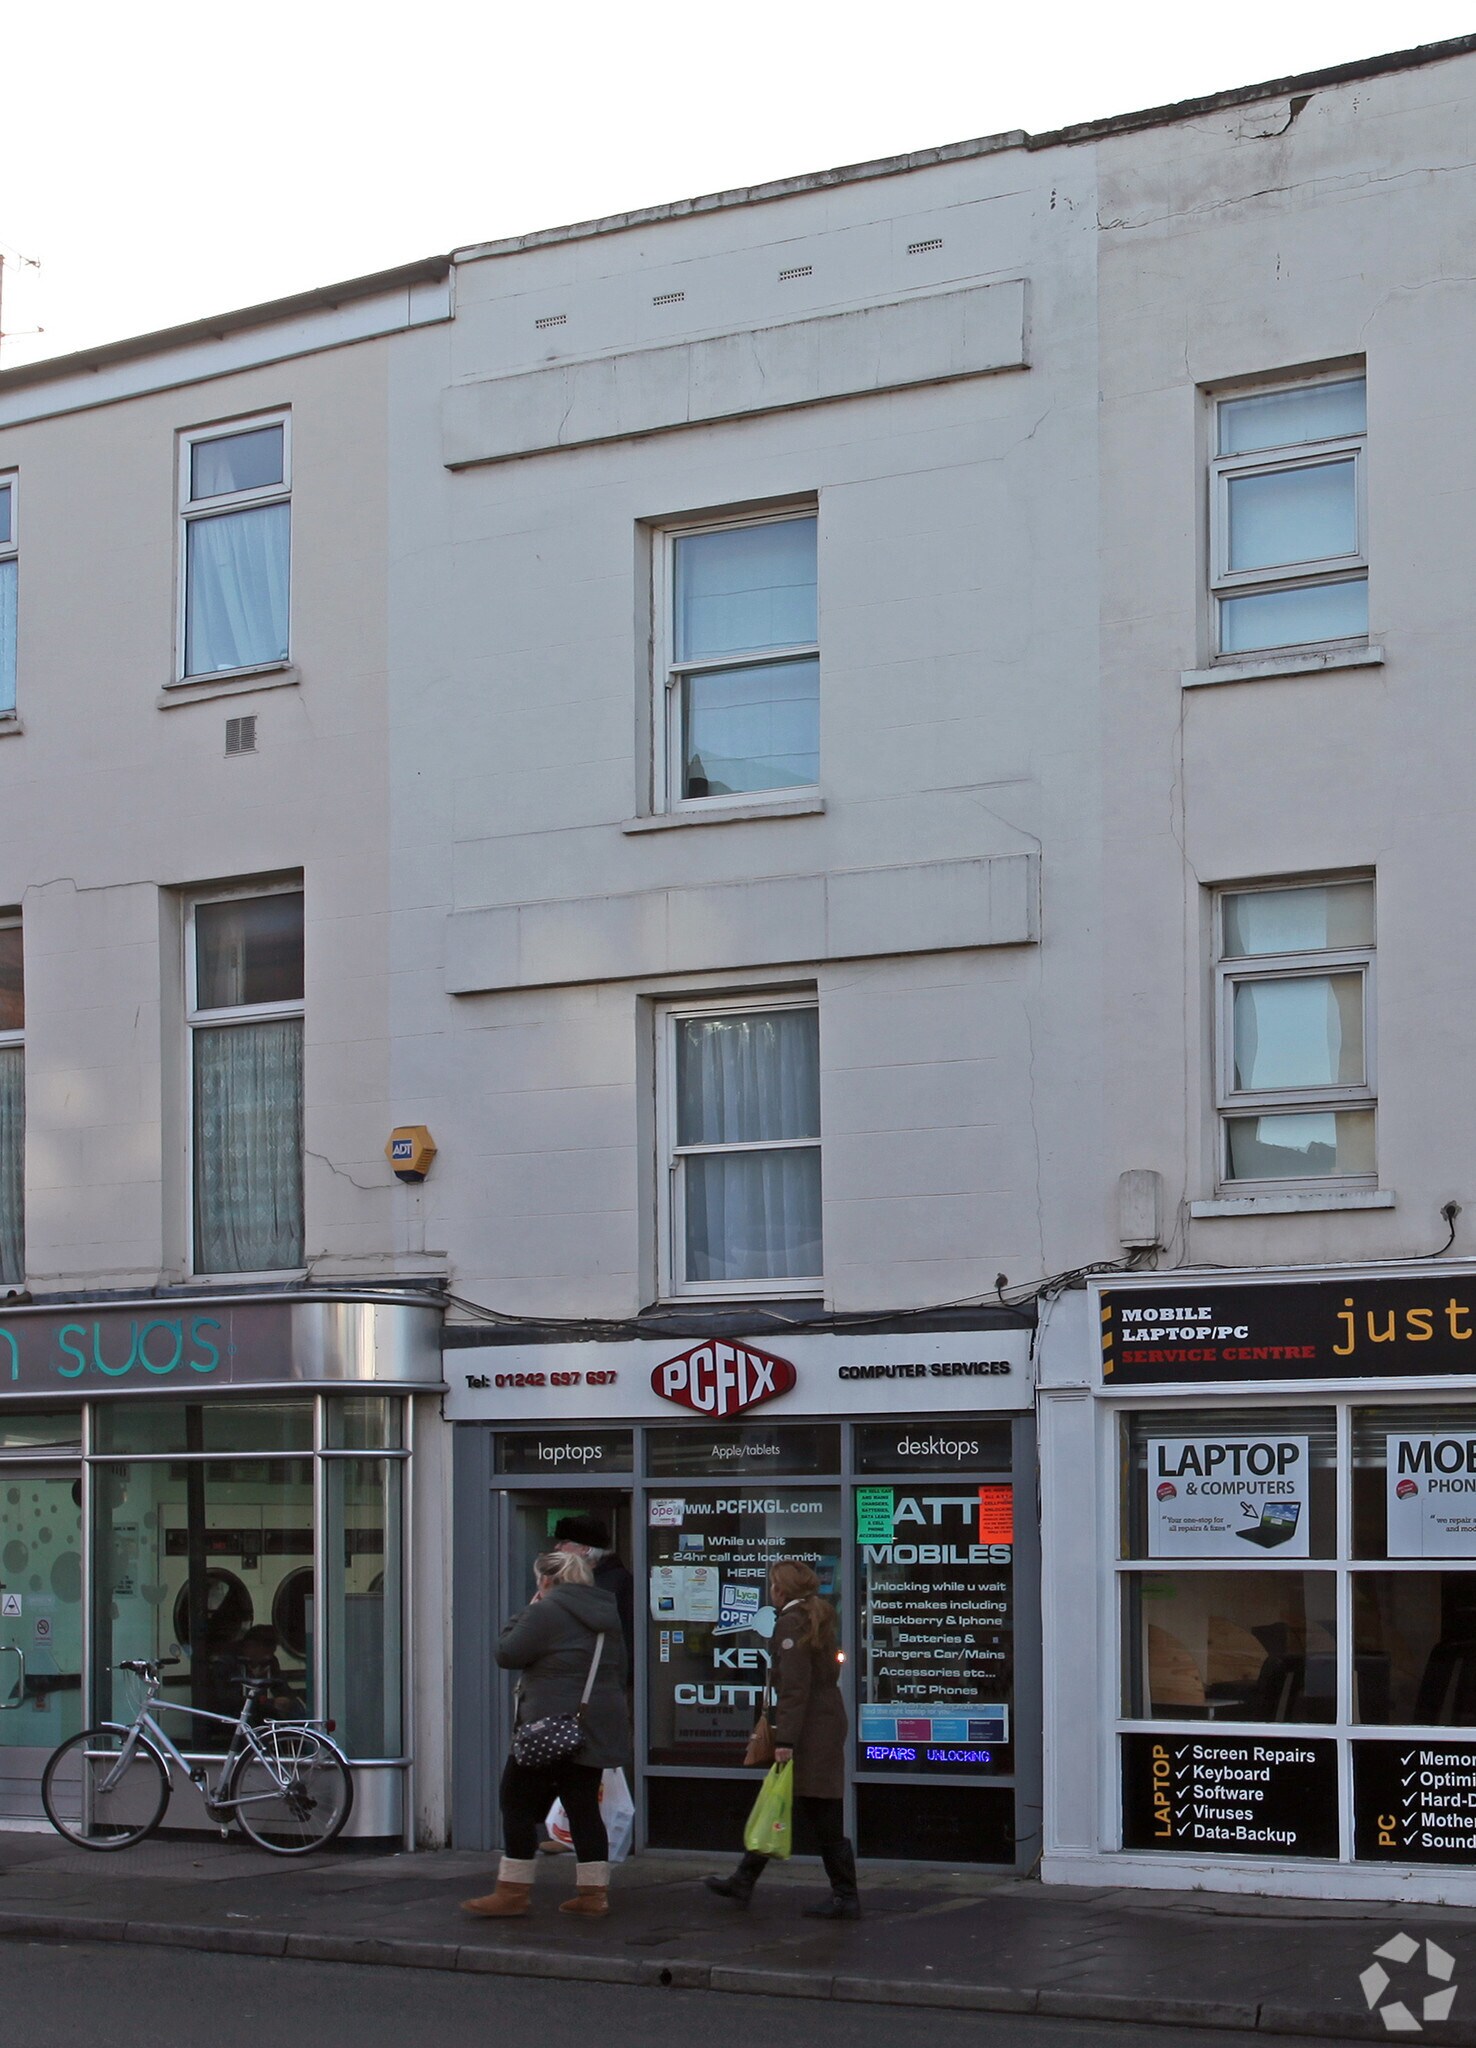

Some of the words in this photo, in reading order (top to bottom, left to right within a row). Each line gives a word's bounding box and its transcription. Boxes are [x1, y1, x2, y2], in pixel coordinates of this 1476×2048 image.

[392, 1144, 412, 1155] ADT
[1122, 1307, 1212, 1322] MOBILE
[1122, 1326, 1248, 1342] LAPTOP/PC
[1333, 1298, 1472, 1356] just
[1122, 1348, 1217, 1363] SERVICE
[1223, 1346, 1316, 1361] CENTRE
[838, 1364, 926, 1380] COMPUTER
[930, 1360, 1012, 1376] SERVICES
[466, 1374, 490, 1388] Tel:
[494, 1372, 546, 1388] 01242
[550, 1372, 580, 1386] 697
[586, 1370, 616, 1385] 697
[663, 1342, 776, 1416] PCFIX
[538, 1442, 602, 1466] laptops
[712, 1443, 780, 1458] Apple/tablets
[897, 1436, 979, 1460] desktops
[1158, 1443, 1300, 1476] LAPTOP
[1186, 1482, 1198, 1495] &
[1201, 1481, 1295, 1495] COMPUTERS
[1428, 1479, 1476, 1492] PHON
[891, 1497, 982, 1525] ATT
[1183, 1516, 1212, 1525] one-stop
[708, 1536, 744, 1546] While
[757, 1536, 786, 1546] wait
[673, 1553, 706, 1562] 24hr
[709, 1553, 730, 1562] call
[733, 1553, 756, 1562] out
[758, 1553, 822, 1562] locksmith
[863, 1544, 1012, 1564] MOBILES
[727, 1569, 766, 1578] HERE
[736, 1590, 758, 1600] Lyca
[869, 1582, 930, 1593] Unlocking
[932, 1582, 964, 1591] while
[978, 1582, 1006, 1591] wait
[869, 1600, 903, 1609] Most
[905, 1600, 947, 1609] makes
[950, 1600, 1007, 1612] including
[872, 1616, 943, 1627] Blackberry
[946, 1616, 956, 1625] &
[959, 1616, 1002, 1627] Iphone
[899, 1634, 962, 1643] Batteries
[964, 1634, 975, 1643] &
[714, 1648, 772, 1669] KEY
[870, 1649, 931, 1660] Chargers
[934, 1648, 1005, 1660] Car/Mains
[879, 1667, 960, 1677] Accessories
[963, 1669, 996, 1678] etc...
[674, 1684, 778, 1706] CUTTI
[897, 1685, 927, 1694] HTC
[929, 1685, 978, 1695] Phones
[866, 1746, 916, 1760] REPAIRS
[927, 1750, 990, 1762] UNLOCKING
[1193, 1745, 1248, 1761] Screen
[1254, 1746, 1316, 1765] Repairs
[1420, 1751, 1476, 1766] Memor
[1193, 1765, 1270, 1783] Keyboard
[1420, 1772, 1476, 1789] Optimi
[1153, 1744, 1172, 1836] LAPTOP
[1193, 1785, 1264, 1801] Software
[1421, 1792, 1476, 1808] Hard-D
[1194, 1804, 1254, 1820] Viruses
[1422, 1812, 1476, 1828] Mothe
[1194, 1824, 1297, 1845] Data-Backup
[1378, 1814, 1396, 1846] PC
[1422, 1833, 1476, 1848] Sound
